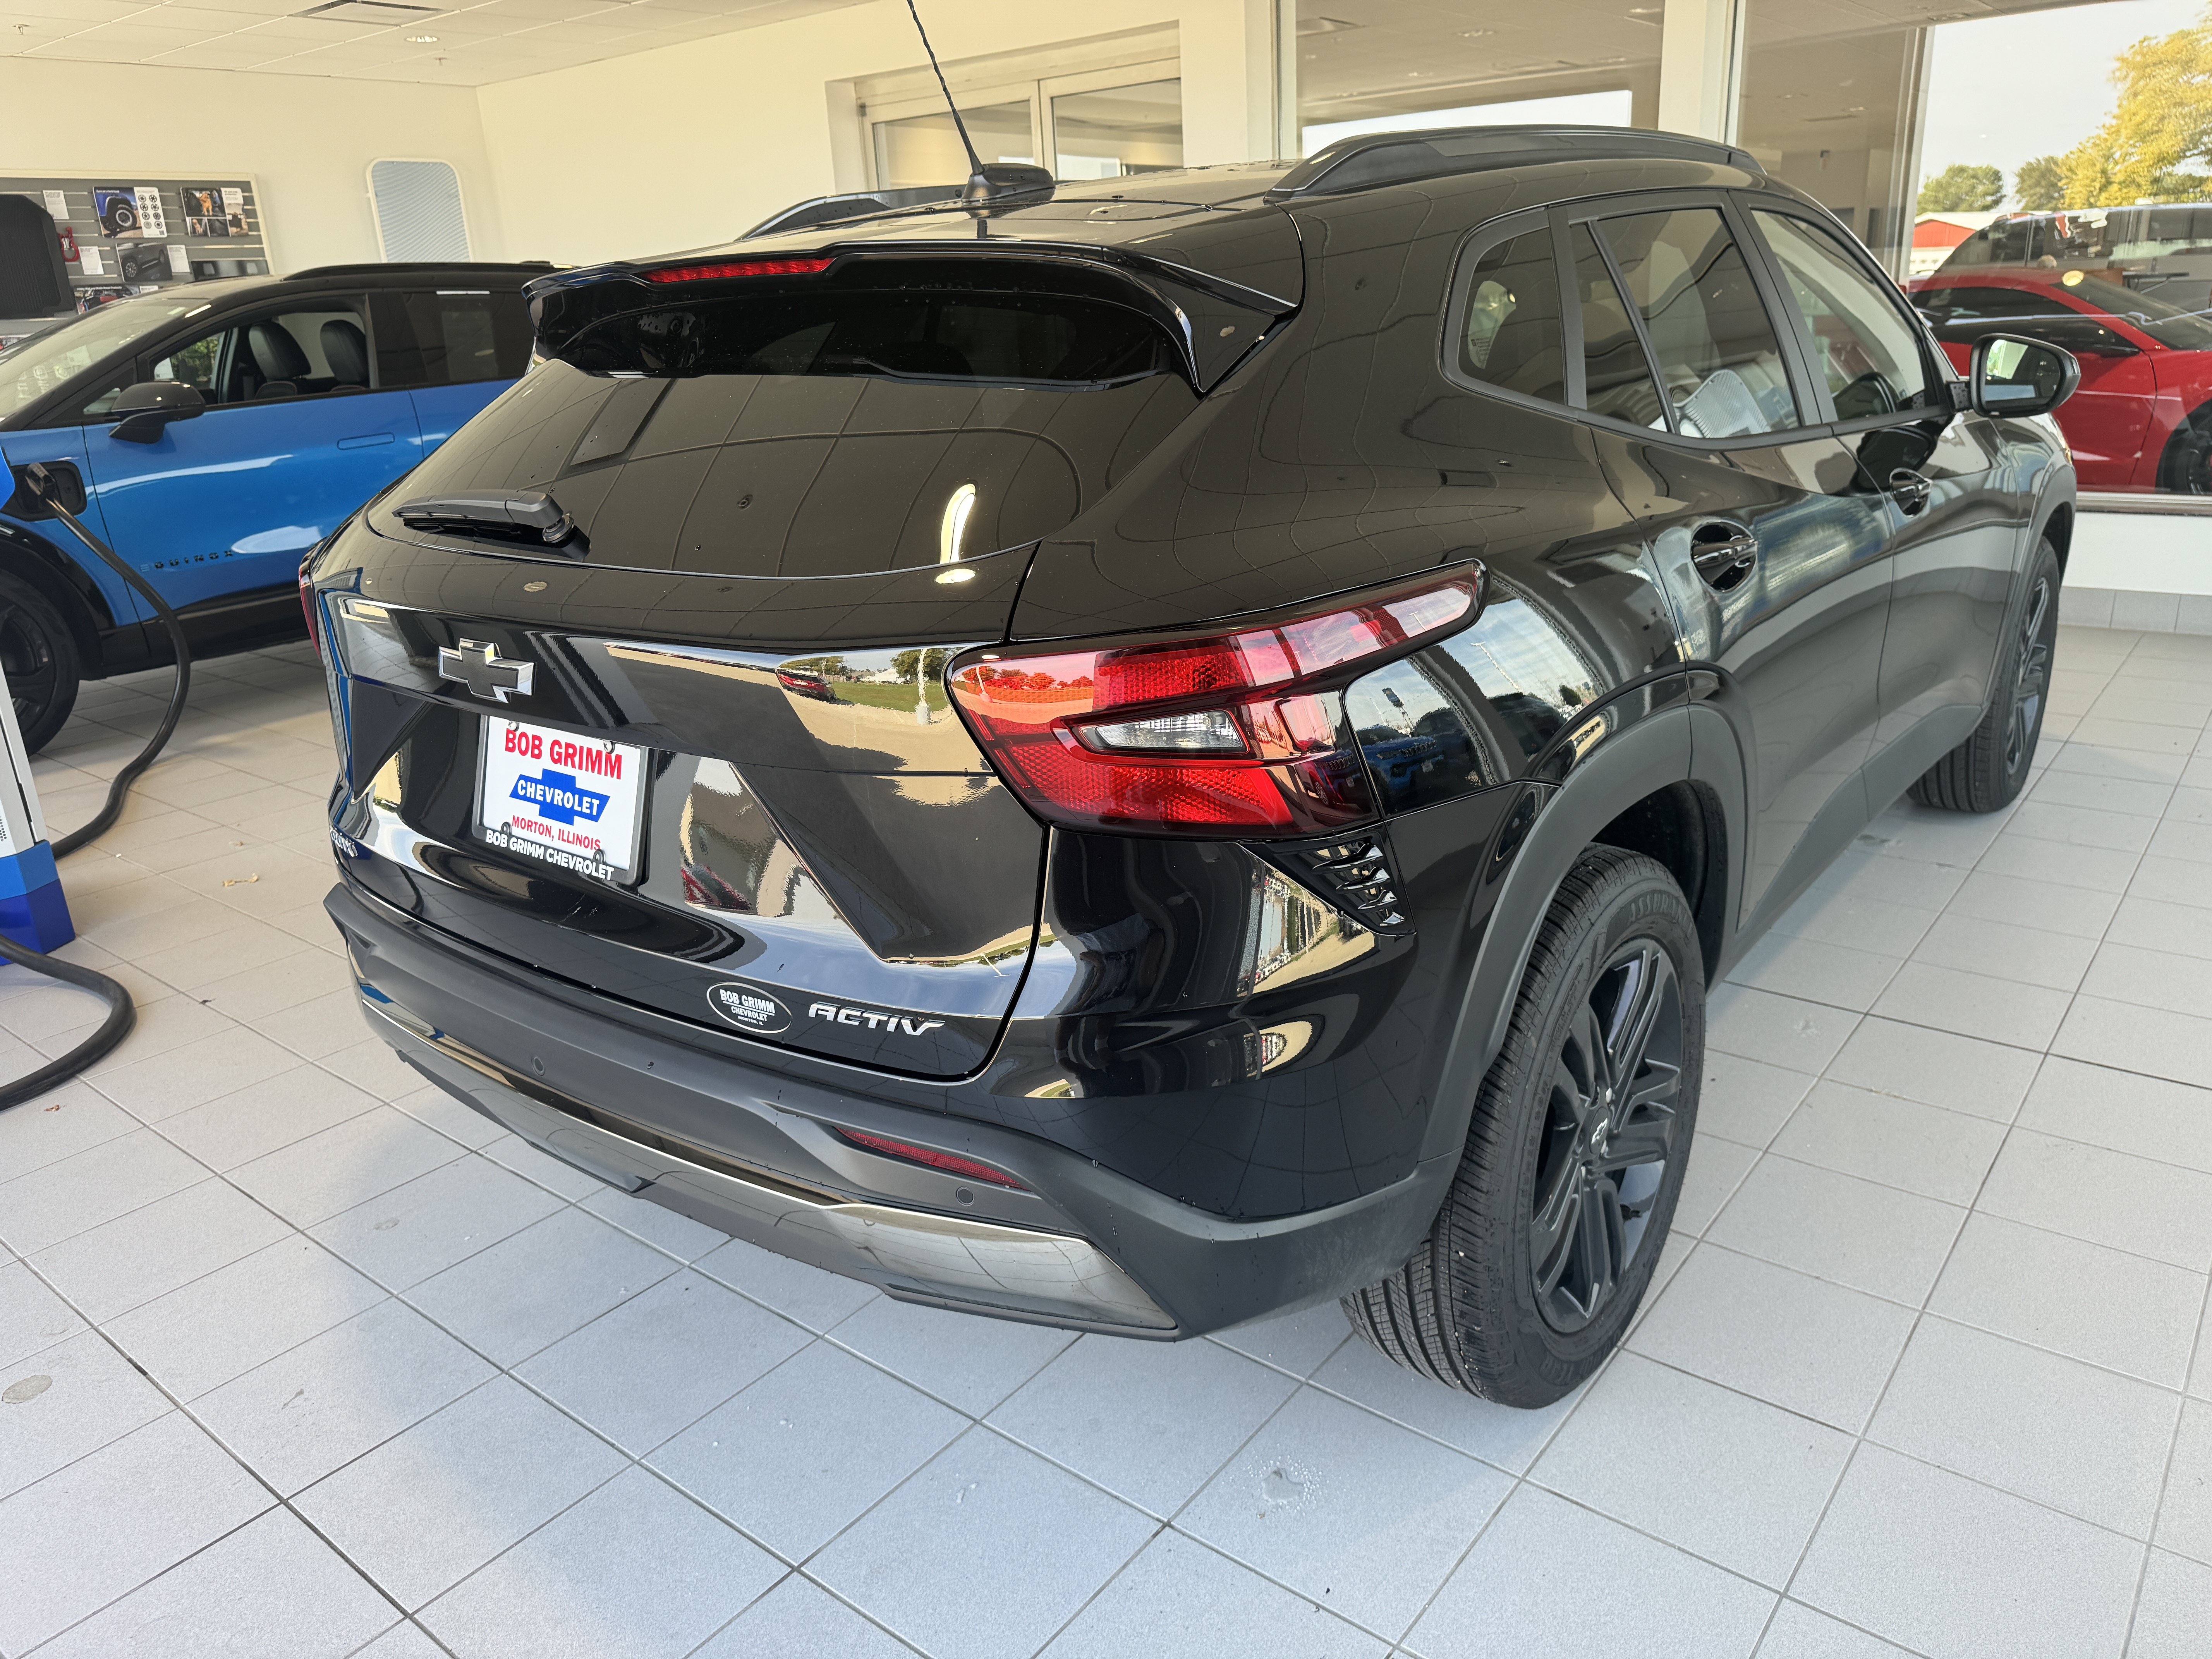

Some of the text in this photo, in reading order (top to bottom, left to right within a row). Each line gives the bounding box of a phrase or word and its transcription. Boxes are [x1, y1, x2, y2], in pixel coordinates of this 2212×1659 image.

[140, 550, 233, 572] EQUINOX
[505, 728, 622, 780] BOB GRIMM
[517, 779, 600, 816] CHEVROLET
[512, 815, 601, 851] MORTON, ILLINOIS
[486, 829, 614, 881] BOB GRIMM CHEVROLET
[720, 989, 775, 1014] BOB GRIMM
[731, 1006, 768, 1022] CHEVROLET
[808, 1001, 946, 1036] ACTIV
[738, 1015, 759, 1025] MORTON,
